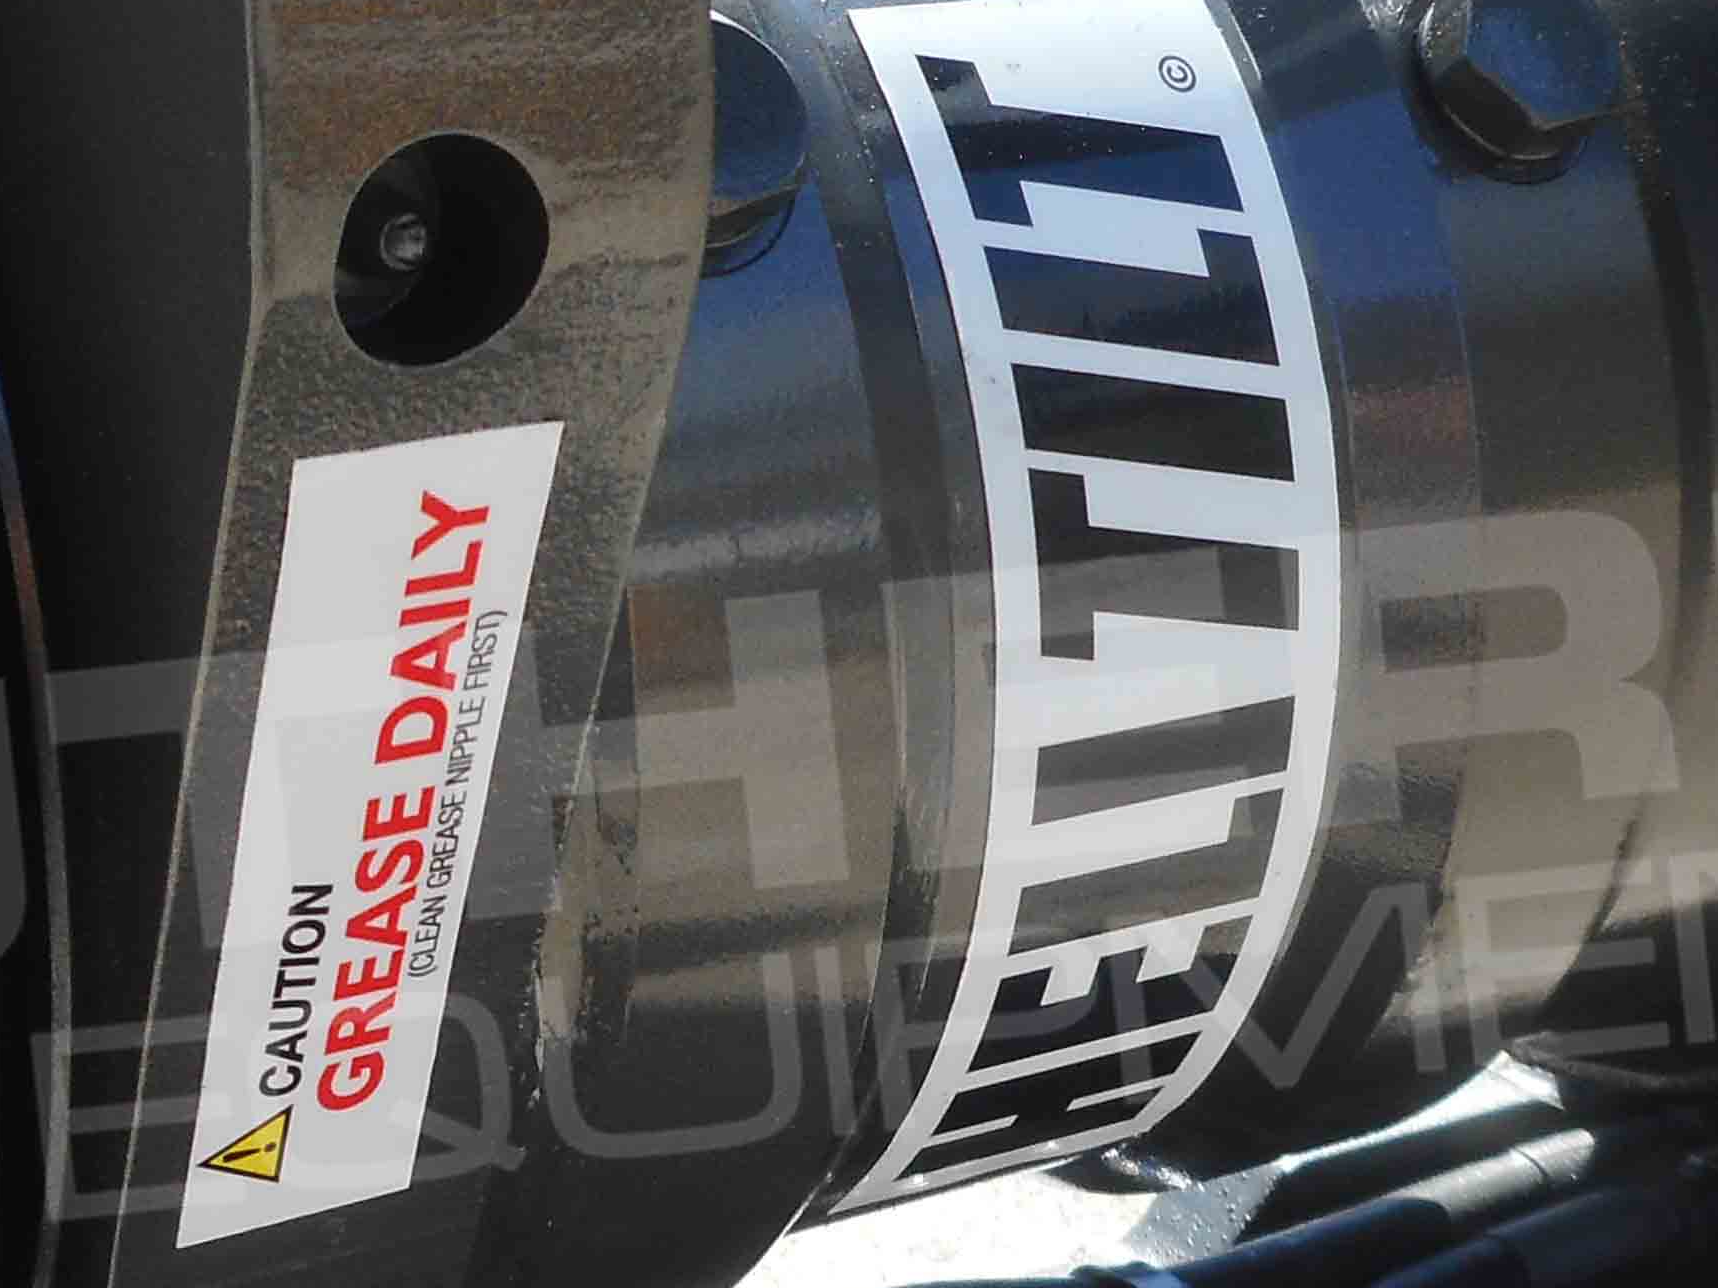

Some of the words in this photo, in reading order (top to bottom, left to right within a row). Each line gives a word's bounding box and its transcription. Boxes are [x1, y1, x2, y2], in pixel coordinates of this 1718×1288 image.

[373, 491, 492, 767] DAILY
[463, 610, 508, 692] FIRST)
[445, 695, 485, 787] NIPPLE
[426, 790, 467, 889] GREASE
[315, 785, 439, 1113] GREASE
[407, 894, 447, 977] (CLEAN
[258, 884, 334, 1098] CAUTION
